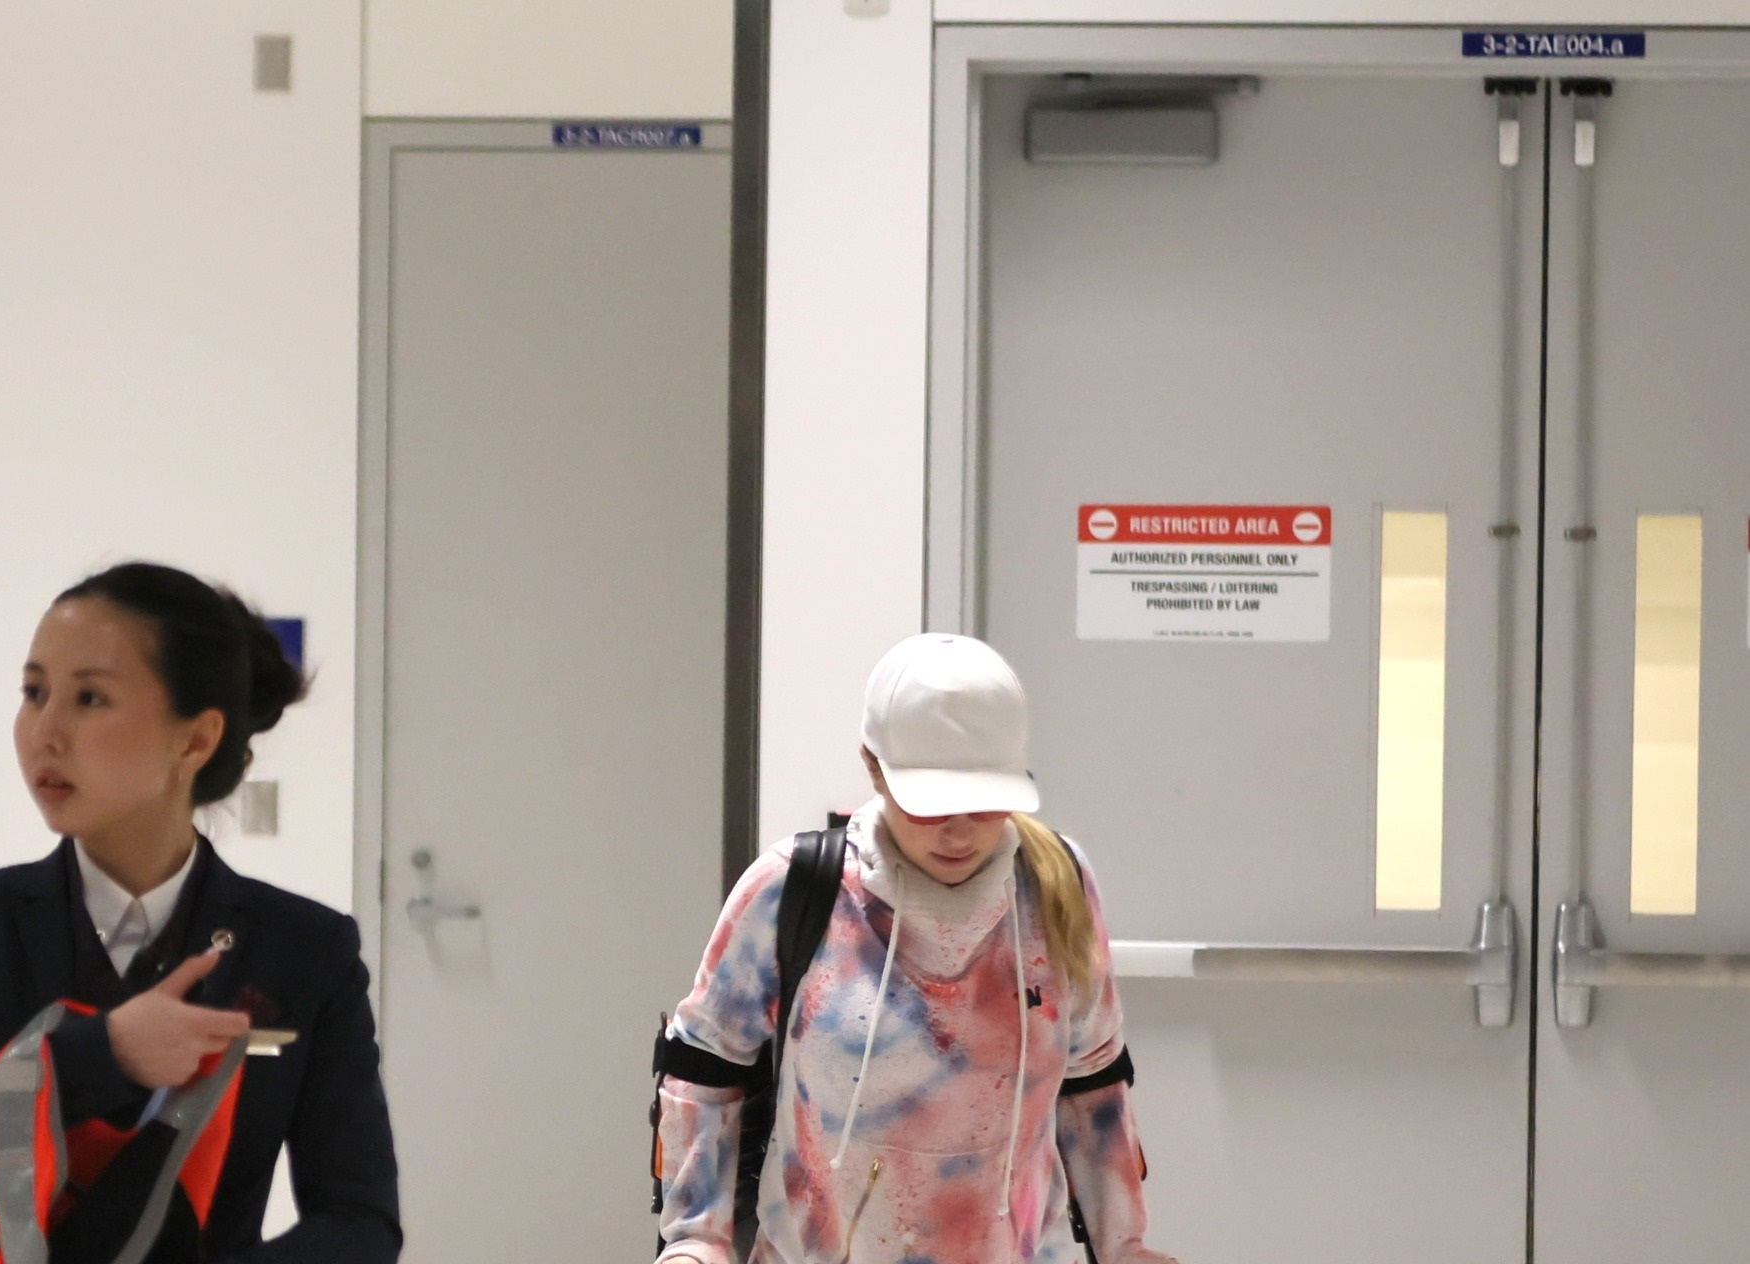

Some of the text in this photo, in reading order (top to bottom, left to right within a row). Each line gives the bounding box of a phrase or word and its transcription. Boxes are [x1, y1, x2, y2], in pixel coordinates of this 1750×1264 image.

[1483, 33, 1625, 55] 3-2-TAE004.a
[1129, 516, 1279, 536] RESTRICTED AREA
[1110, 551, 1298, 567] AUTHORIZED PERSONNEL ONLY
[1131, 581, 1207, 593] TRESPASSING
[1219, 582, 1278, 594] LOITERING
[1146, 598, 1260, 611] PROHIBITED BY LAW
